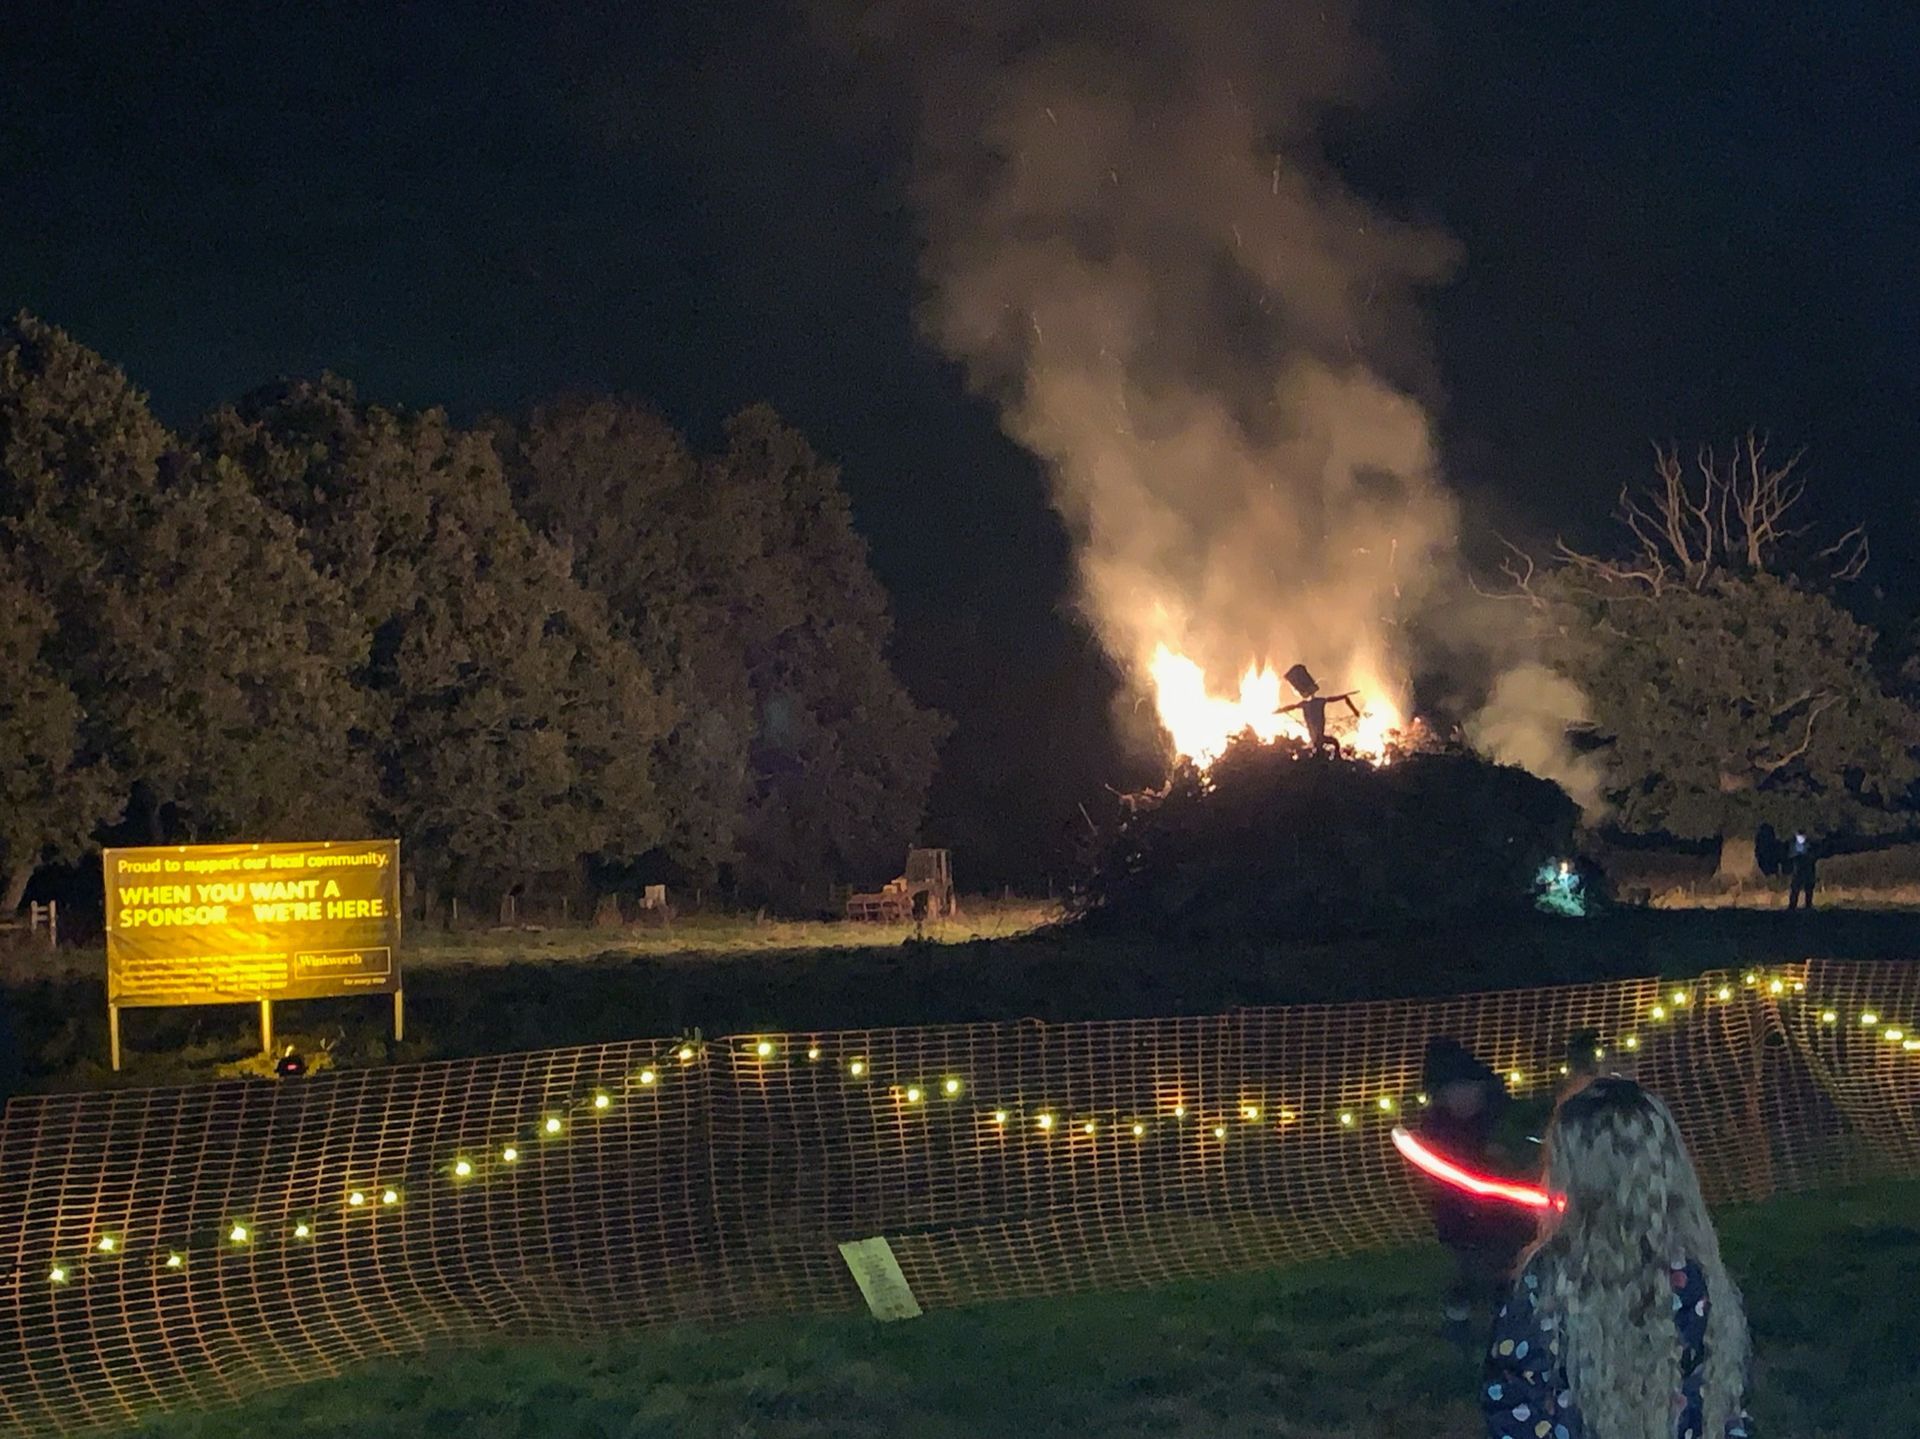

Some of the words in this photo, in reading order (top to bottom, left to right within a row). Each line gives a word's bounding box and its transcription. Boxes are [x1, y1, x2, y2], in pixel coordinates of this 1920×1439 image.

[117, 860, 160, 873] Proud
[165, 859, 180, 871] to
[183, 857, 240, 874] support
[243, 858, 267, 870] our
[271, 854, 304, 869] local
[307, 852, 389, 868] community.
[119, 885, 191, 905] WHEN
[196, 883, 245, 903] YOU
[249, 880, 320, 900] WANT
[323, 880, 340, 898] A
[119, 906, 228, 928] SPONSOR
[254, 901, 322, 922] WE'RE
[327, 899, 388, 919] HERE.
[299, 953, 362, 968] Winkworth
